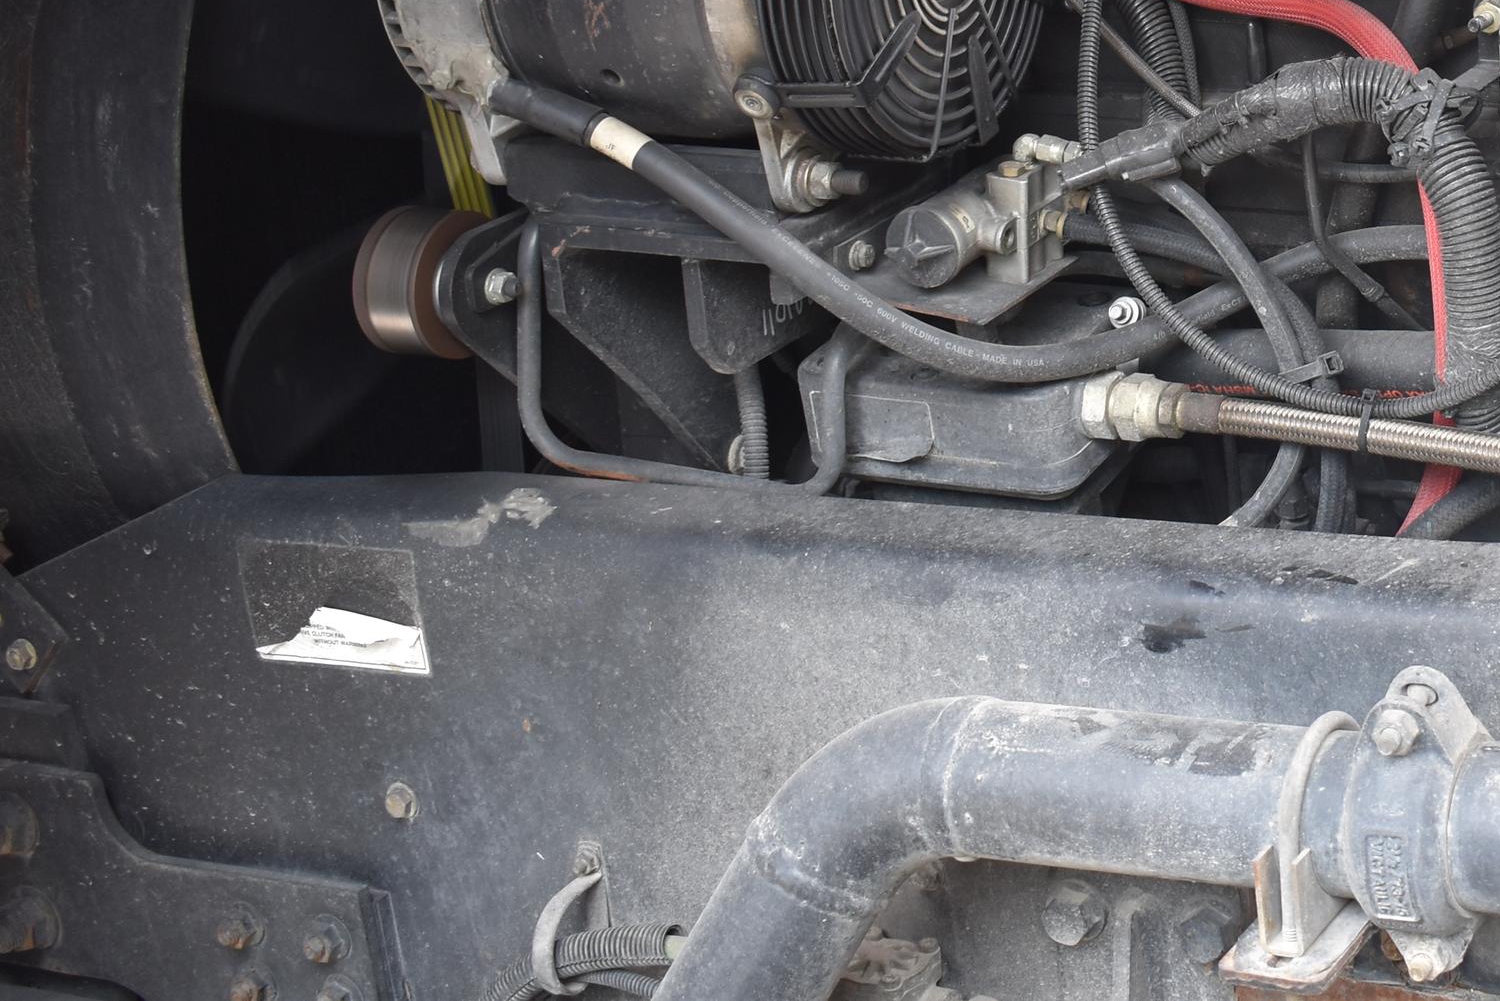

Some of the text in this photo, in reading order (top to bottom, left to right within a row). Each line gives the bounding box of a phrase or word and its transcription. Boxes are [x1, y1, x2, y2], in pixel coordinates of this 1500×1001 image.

[900, 322, 941, 346] WELDING
[944, 341, 975, 358] CABLE
[981, 352, 1008, 366] MADE
[1012, 358, 1023, 366] IN
[1027, 358, 1045, 368] USA
